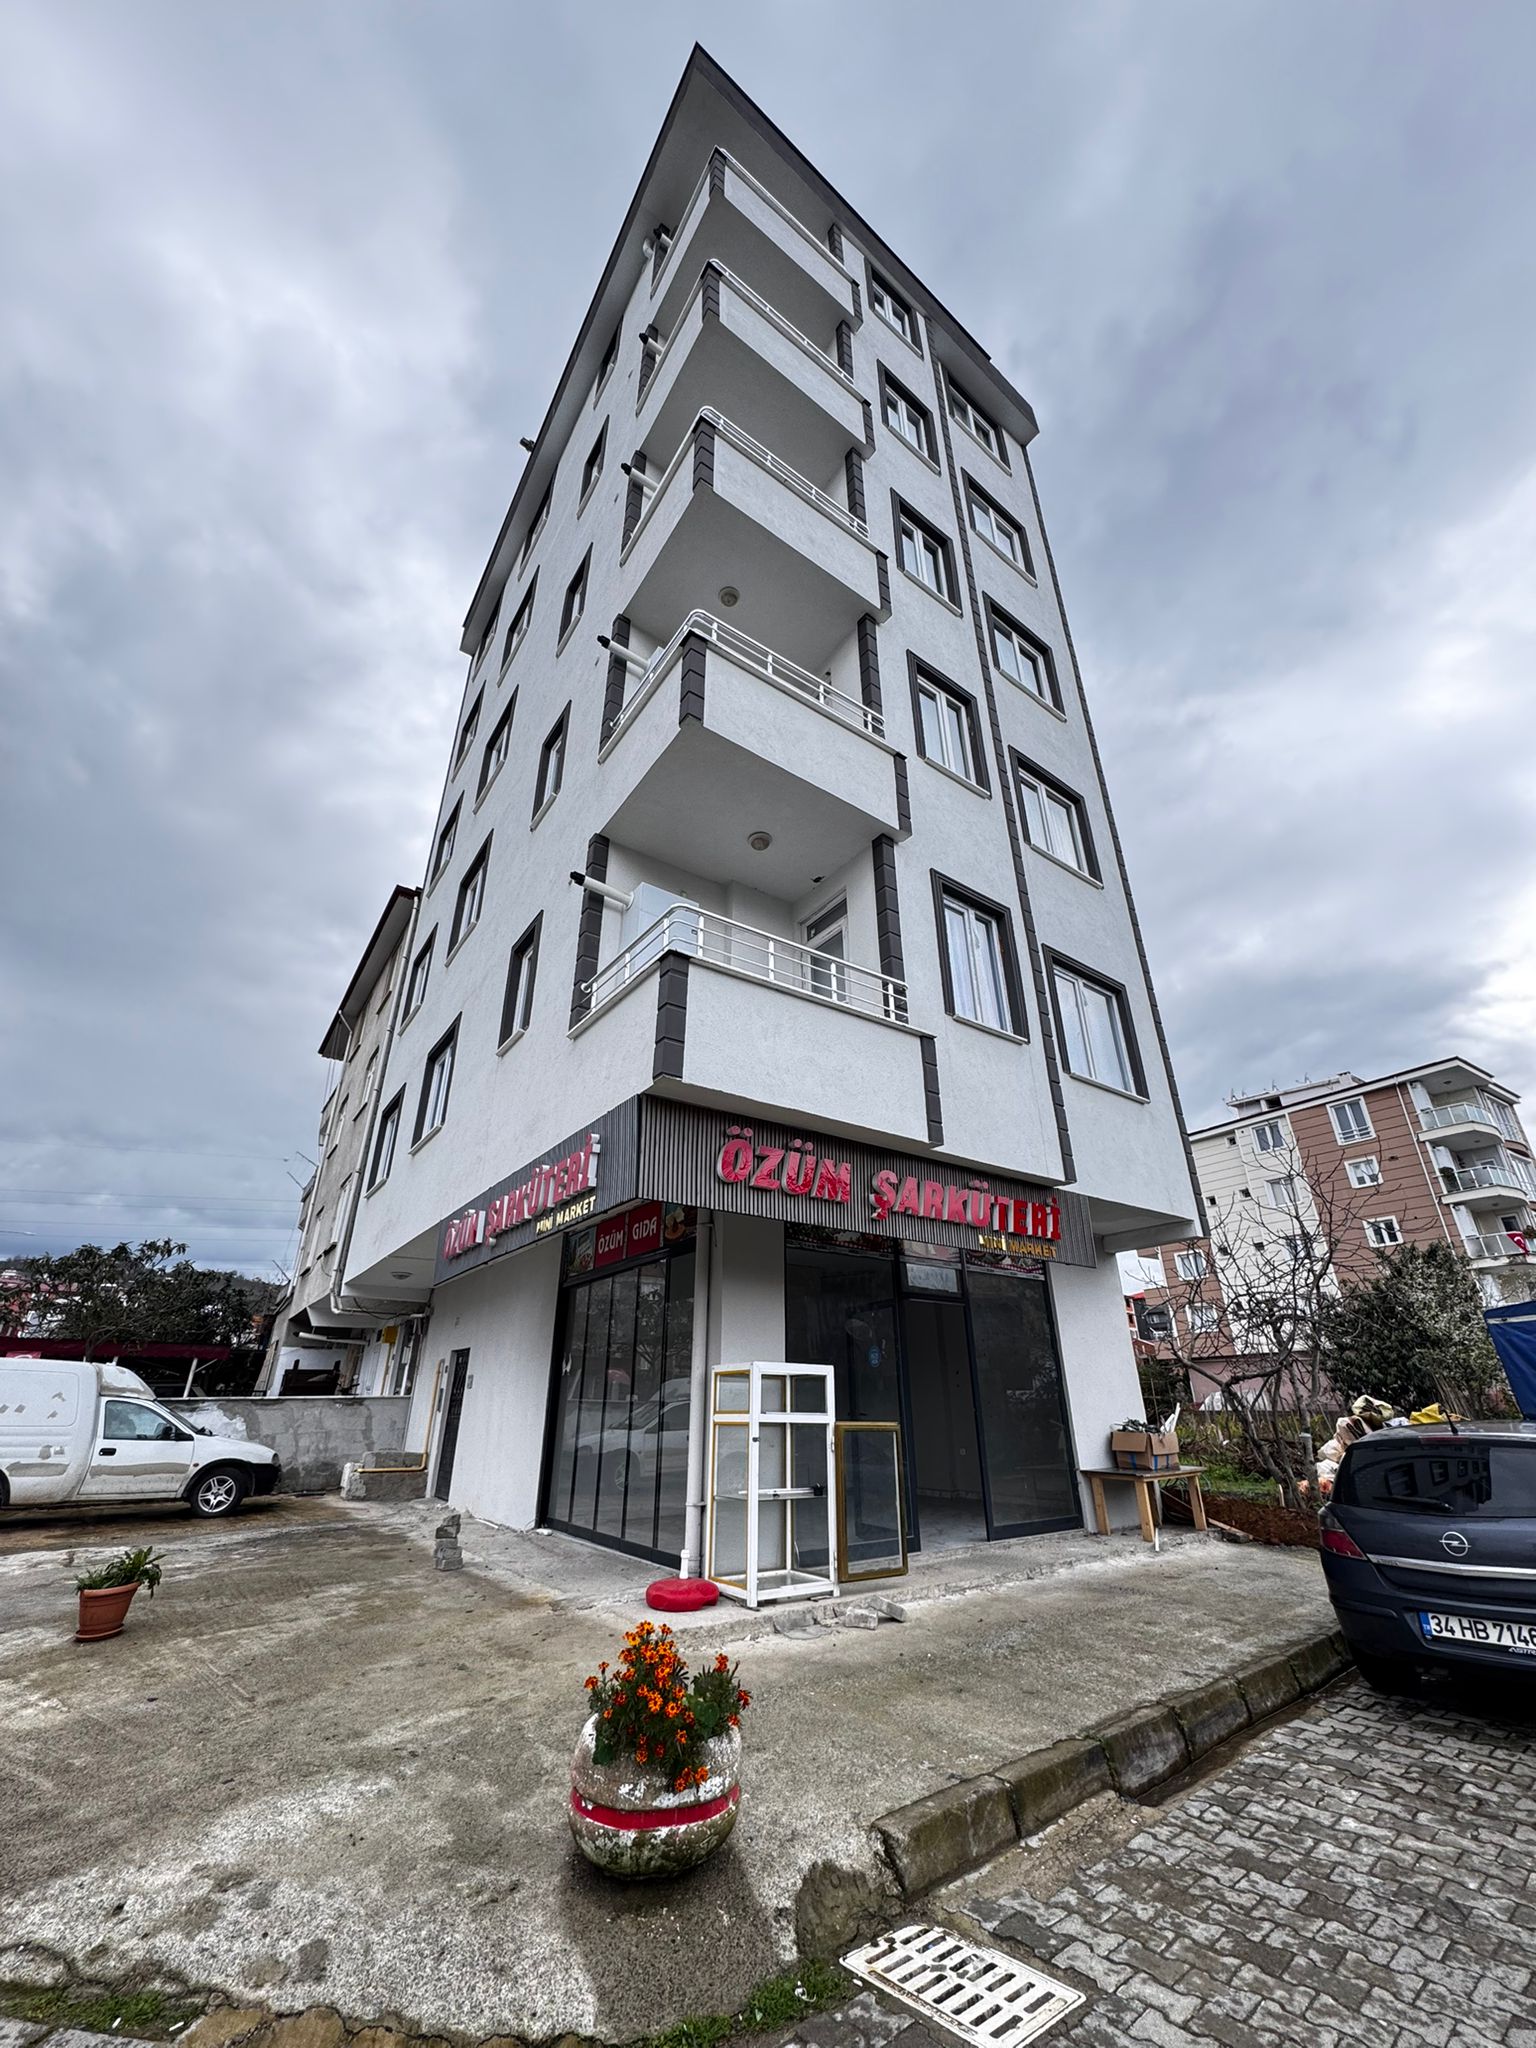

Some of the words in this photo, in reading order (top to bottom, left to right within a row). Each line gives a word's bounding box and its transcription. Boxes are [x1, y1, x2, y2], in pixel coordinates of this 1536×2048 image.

[485, 1133, 601, 1248] ŞARKÜTERİ
[716, 1125, 852, 1204] ÖZÜM
[869, 1169, 1062, 1241] ŞARKÜTERİ
[556, 1195, 597, 1227] MARKET
[598, 1228, 624, 1255] ÖZÜM
[632, 1216, 659, 1241] GIDA
[1009, 1239, 1058, 1258] MARKET
[1430, 1614, 1456, 1636] 34
[1457, 1618, 1490, 1641] HB
[1508, 1647, 1536, 1656] ASTR
